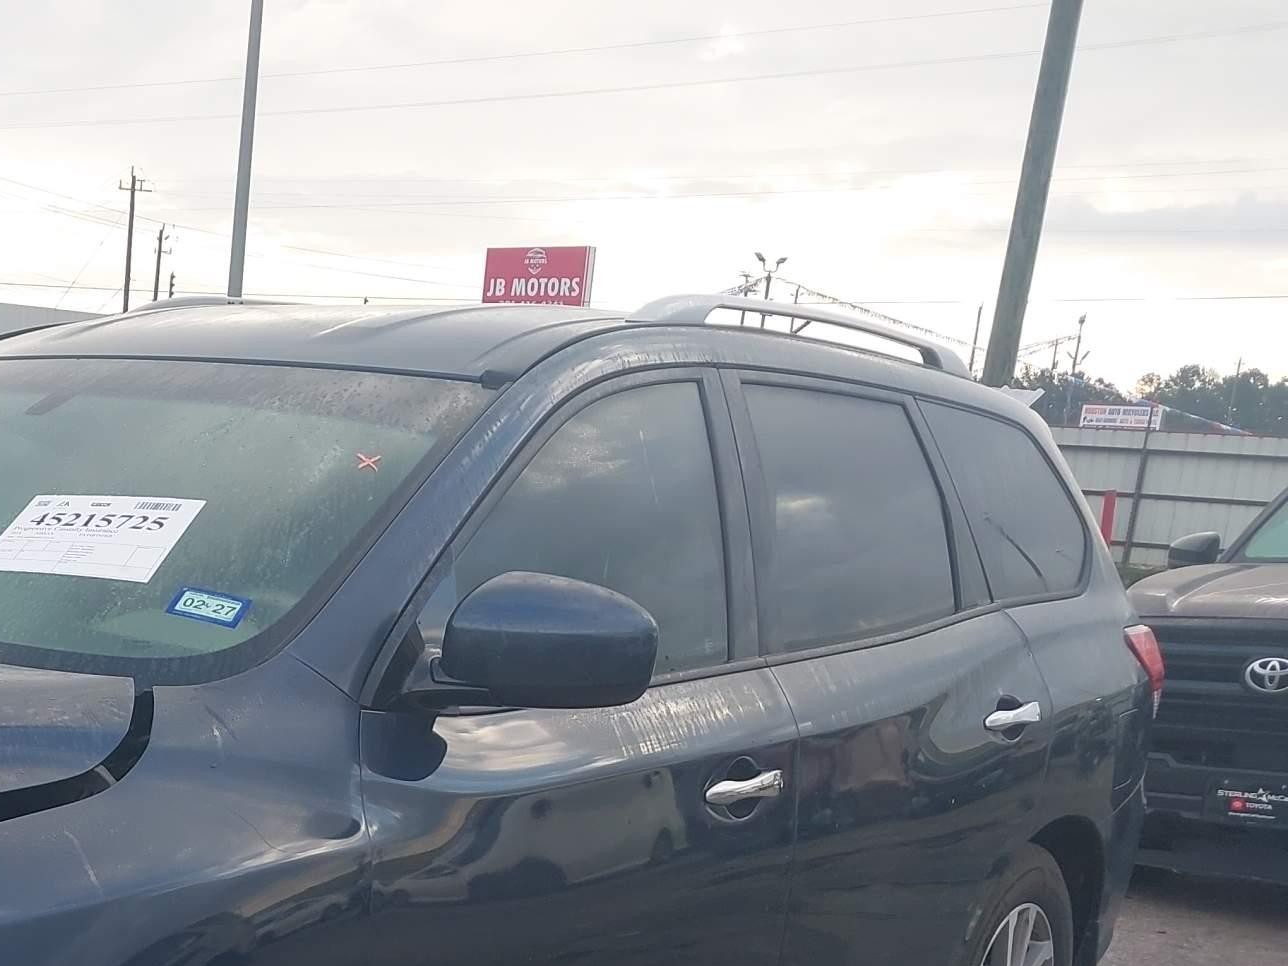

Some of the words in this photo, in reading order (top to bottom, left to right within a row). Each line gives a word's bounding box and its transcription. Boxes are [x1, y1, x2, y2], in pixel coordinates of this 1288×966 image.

[487, 278, 506, 296] JB
[511, 277, 580, 296] MOTORS
[30, 512, 170, 532] 45215725
[183, 597, 206, 610] 02
[212, 603, 237, 616] 27
